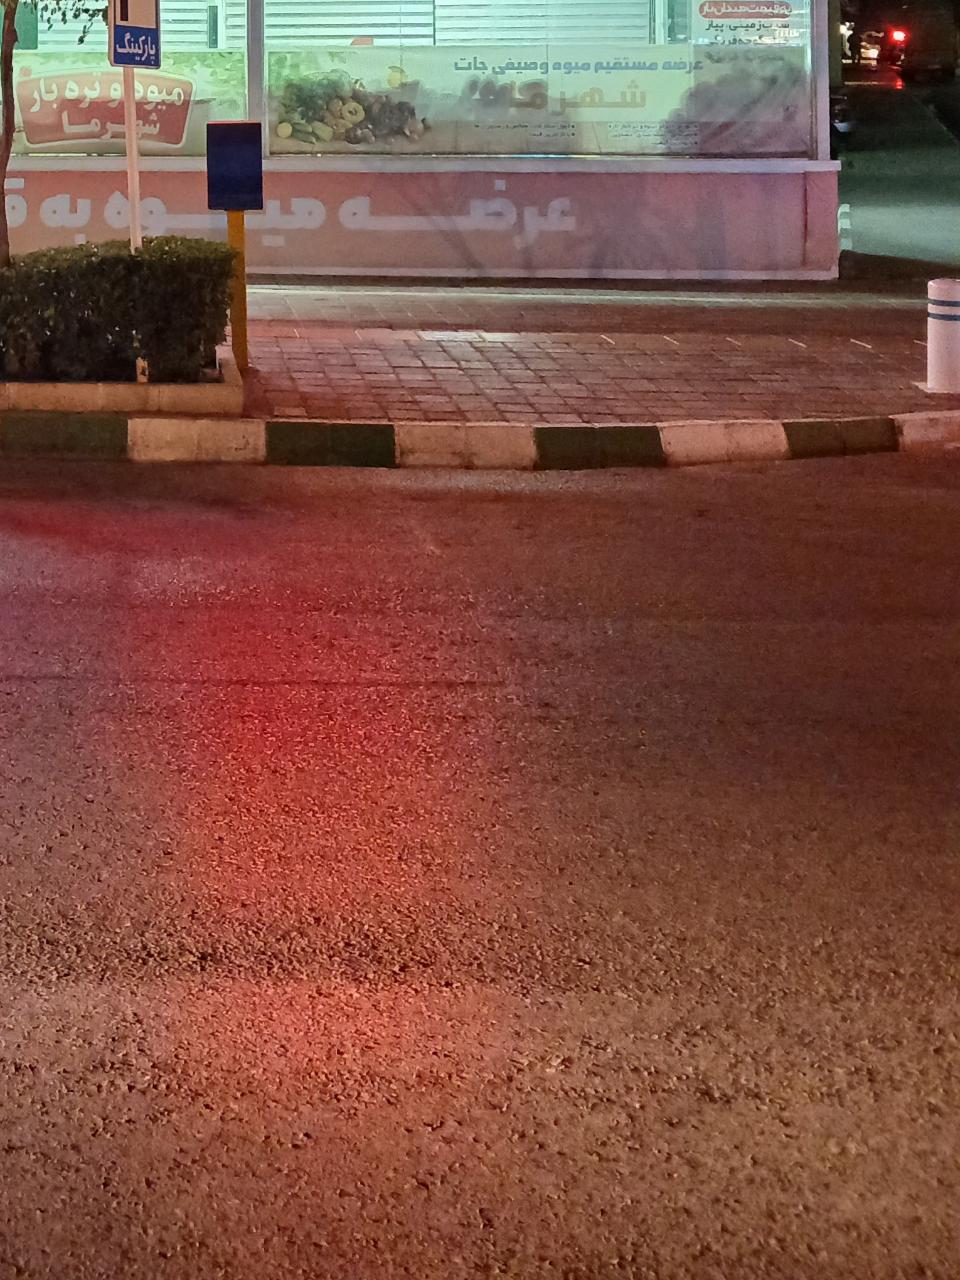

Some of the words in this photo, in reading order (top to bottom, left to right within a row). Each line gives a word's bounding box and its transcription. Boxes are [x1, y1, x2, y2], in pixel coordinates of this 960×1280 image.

[116, 32, 156, 65] پارکینگ
[454, 57, 488, 75] جات
[492, 58, 538, 76] صیفی
[538, 60, 549, 74] و
[552, 61, 591, 75] میوه
[594, 57, 658, 74] مستقیم
[661, 57, 704, 74] عرضه
[30, 77, 58, 113] بار
[63, 71, 101, 109] تره
[107, 81, 123, 108] و
[40, 193, 92, 246] به
[103, 192, 327, 247] میوه
[339, 179, 577, 251] عرضه
